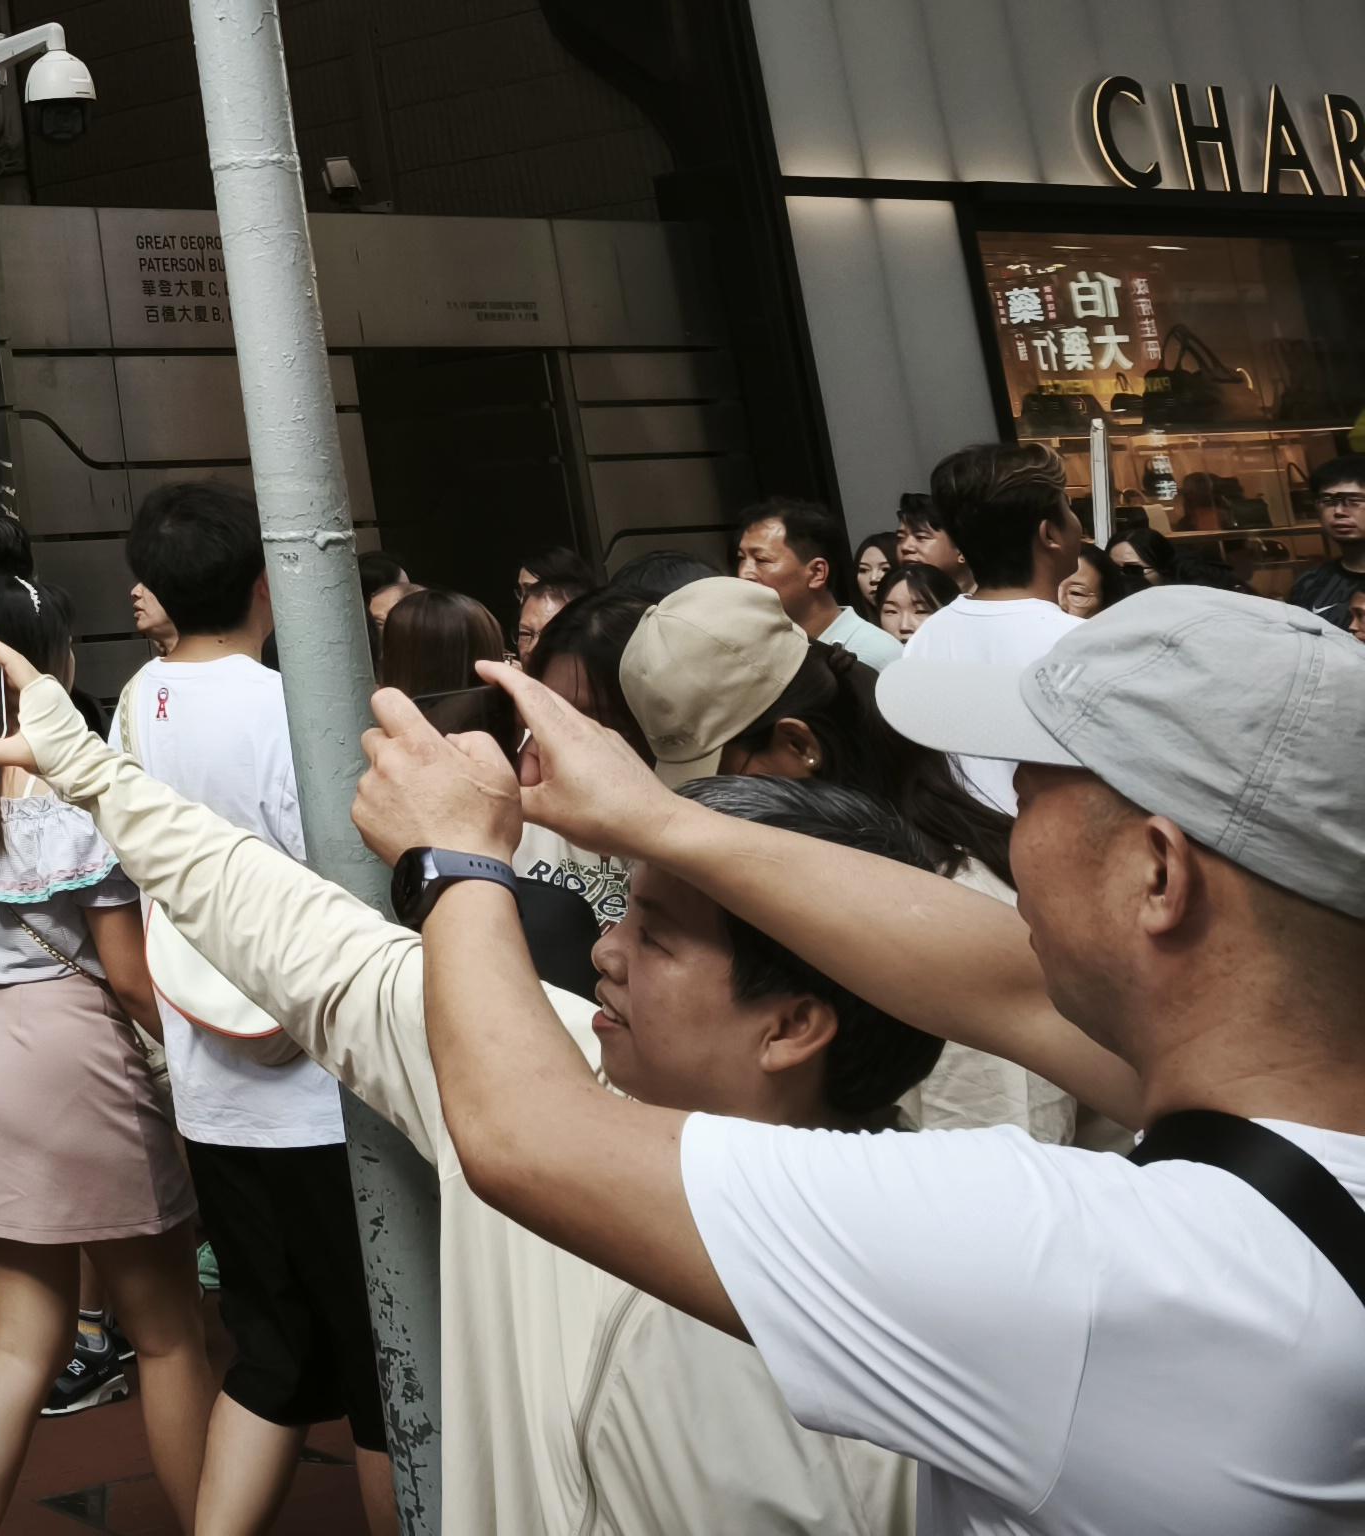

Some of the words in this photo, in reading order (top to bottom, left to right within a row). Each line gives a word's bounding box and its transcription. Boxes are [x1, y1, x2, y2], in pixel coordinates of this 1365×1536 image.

[1091, 74, 1365, 197] CHAR
[136, 235, 176, 250] GREAT
[139, 257, 206, 272] PATERSON
